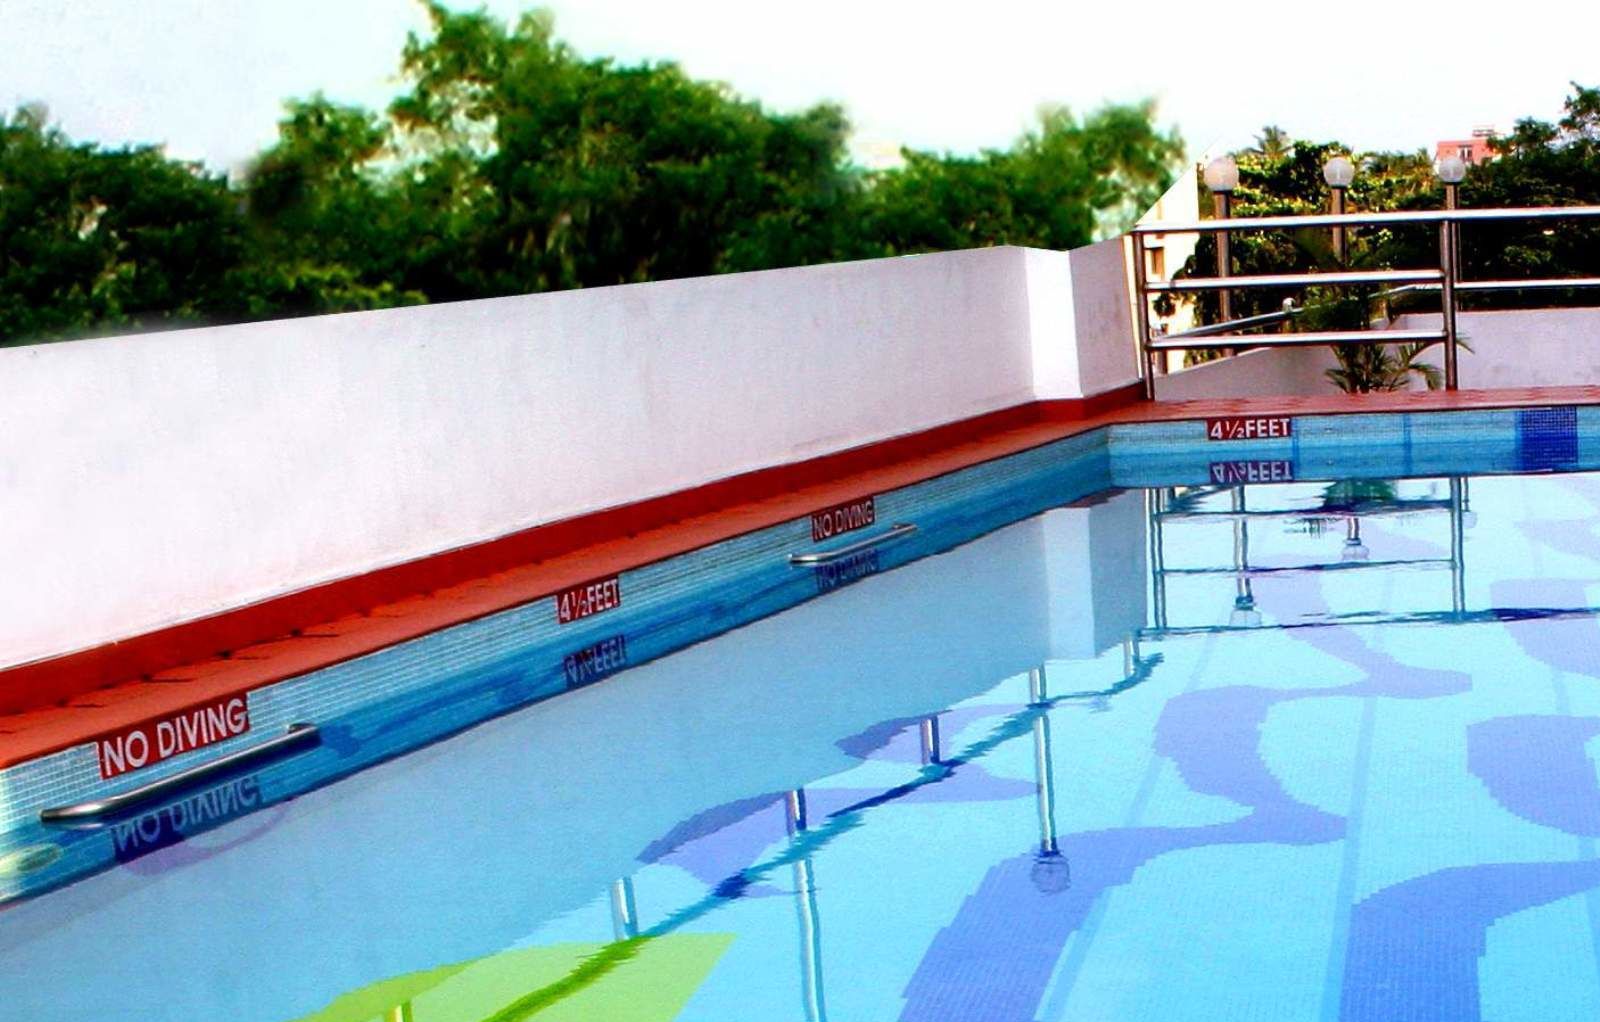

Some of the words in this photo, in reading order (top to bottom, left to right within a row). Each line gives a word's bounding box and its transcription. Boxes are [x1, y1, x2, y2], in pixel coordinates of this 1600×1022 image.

[813, 513, 833, 540] NO
[835, 500, 874, 533] DIVING
[103, 731, 149, 776] NO
[156, 698, 248, 759] DIVING
